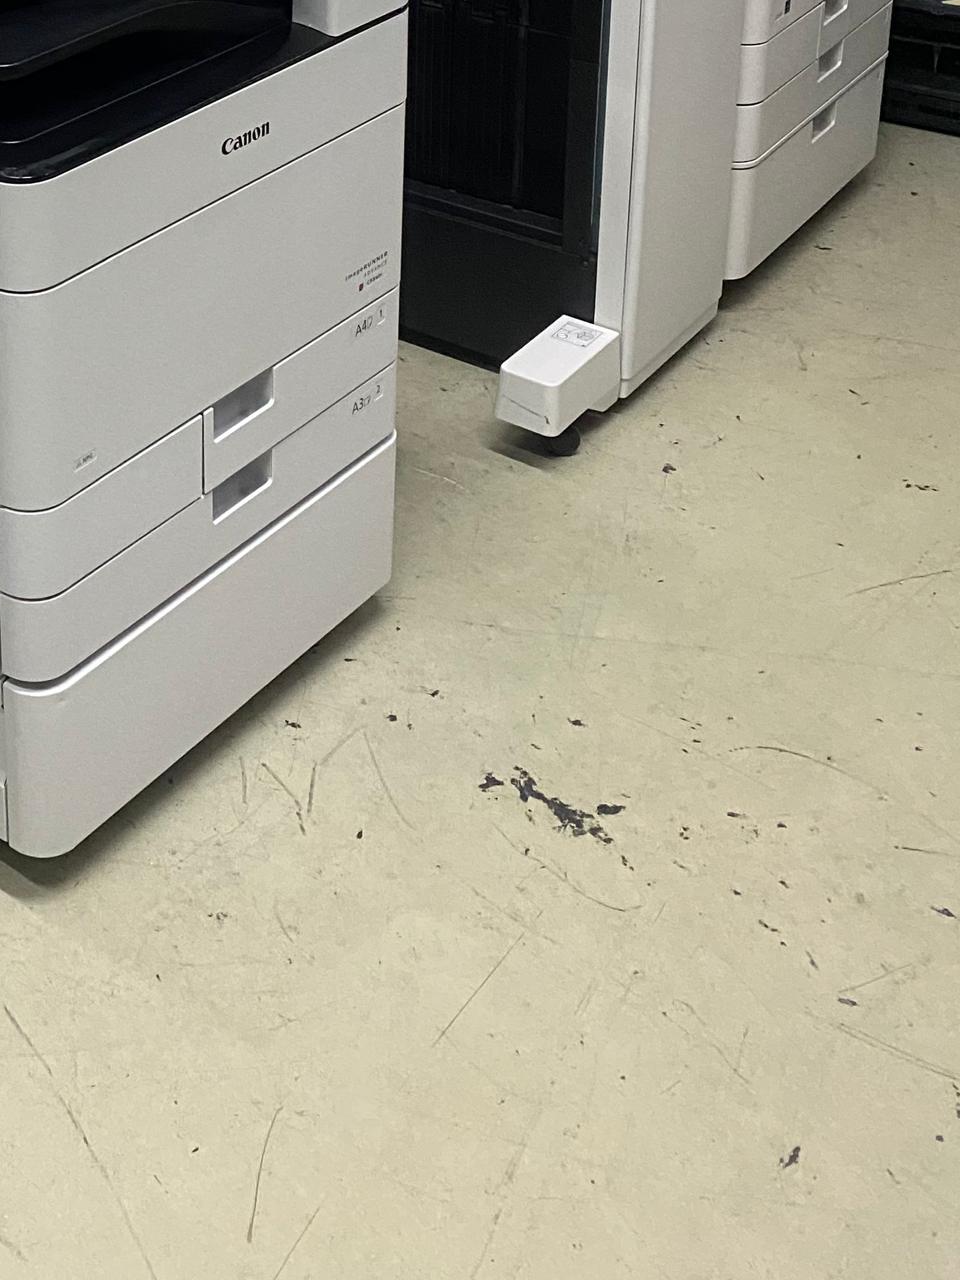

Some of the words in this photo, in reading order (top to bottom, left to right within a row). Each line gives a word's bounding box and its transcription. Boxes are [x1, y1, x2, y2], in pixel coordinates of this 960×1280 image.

[221, 121, 269, 155] Canon
[355, 319, 367, 338] A4
[352, 397, 364, 415] A3
